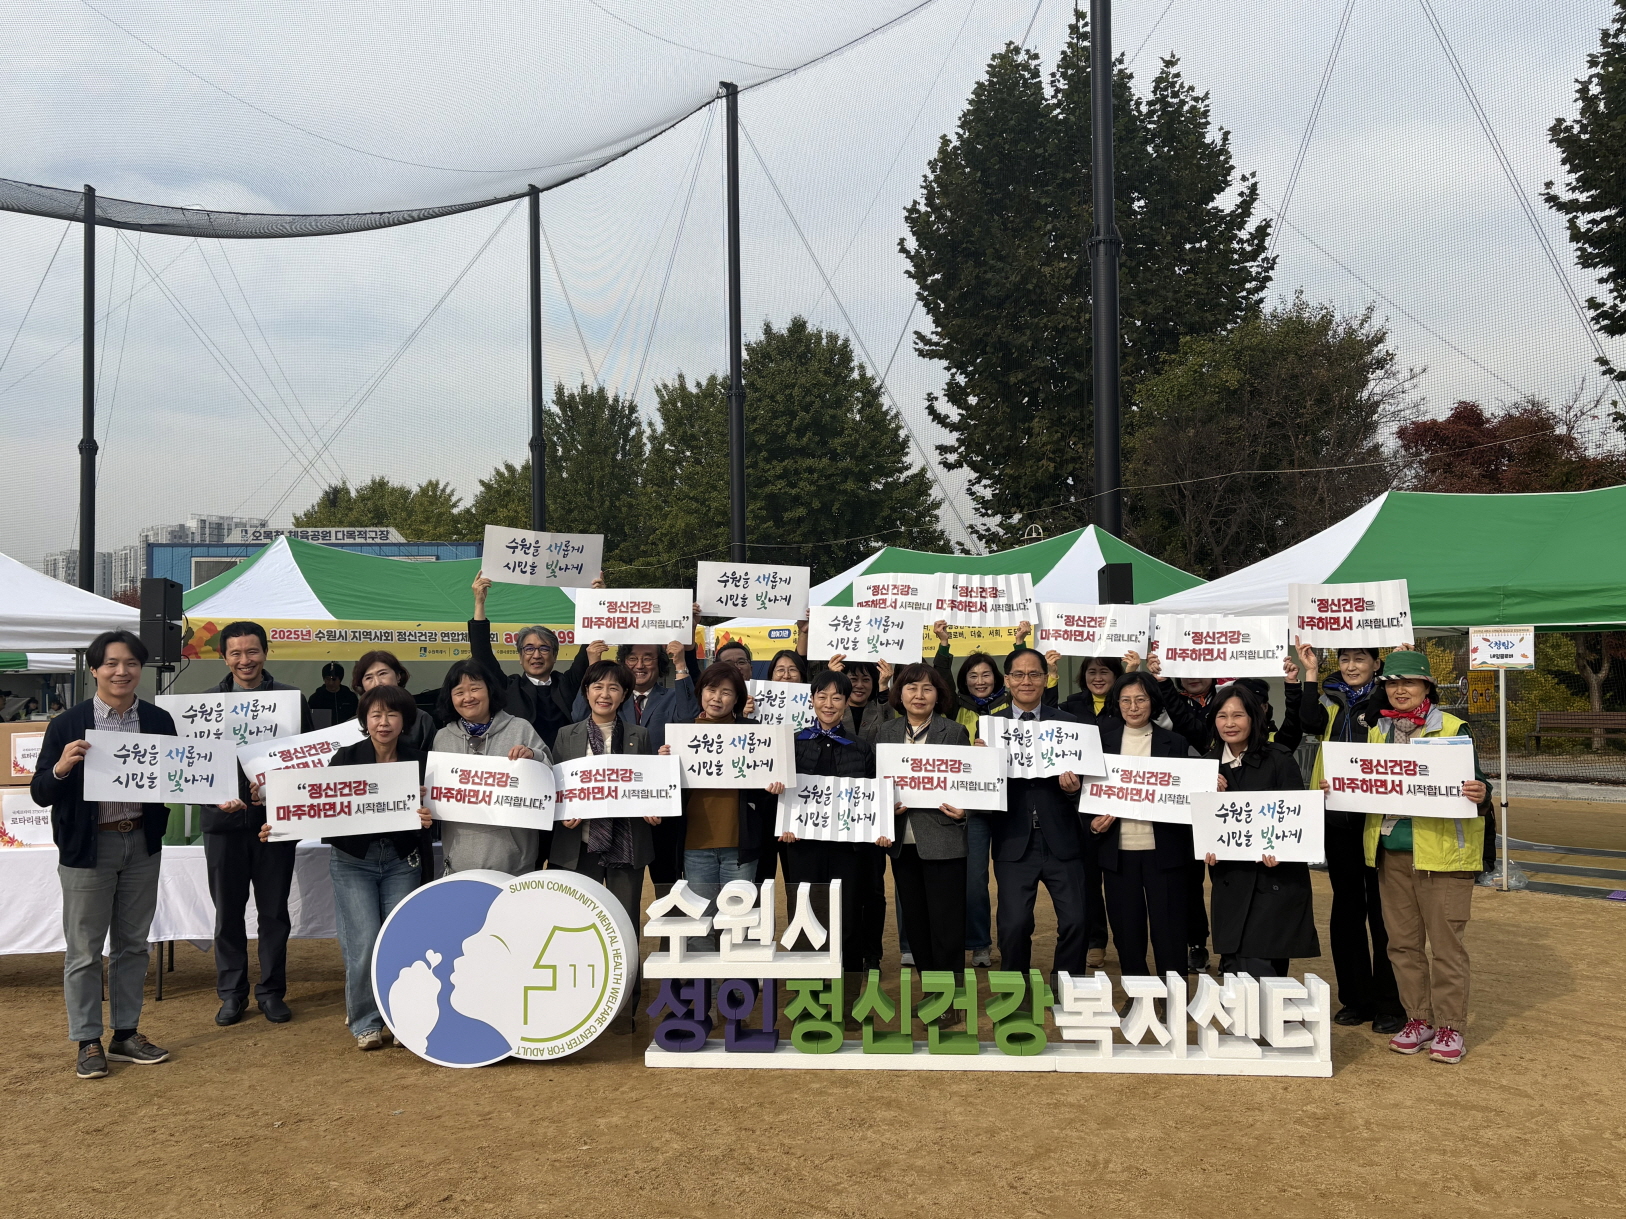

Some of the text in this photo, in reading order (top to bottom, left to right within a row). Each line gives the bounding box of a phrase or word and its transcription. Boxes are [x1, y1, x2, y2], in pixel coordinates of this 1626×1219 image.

[287, 530, 332, 541] 체육공원
[334, 530, 390, 541] 다목적구장
[505, 537, 584, 558] 수원을 새롭게
[503, 560, 584, 579] 시민을 빛나게
[717, 570, 791, 590] 수원을 새롭게
[716, 591, 792, 610] 시민을 빛나게
[952, 584, 1006, 599] “정신건강은
[599, 600, 661, 614] “정신건강은
[936, 599, 988, 613] 마주하면서
[1310, 597, 1375, 613] “정신건강은
[582, 615, 690, 630] 마주하면서 시작합니다.”
[829, 614, 904, 634] 수원을 새롭게
[1297, 611, 1407, 631] 마주하면서 시작합니다.”
[270, 629, 312, 641] 2025년
[314, 629, 348, 643] 수원시
[350, 629, 394, 643] 지역사회
[396, 631, 438, 643] 정신건강
[827, 637, 860, 651] 시민을
[867, 634, 904, 654] 빛나게
[1040, 629, 1095, 643] 마주하면서
[1184, 630, 1251, 646] “정신건강은
[1165, 644, 1284, 663] 마주하면서 시작합니다.”
[754, 689, 814, 710] 수원을 새롭
[182, 698, 276, 724] 수원을 새롭게
[792, 711, 815, 731] 빛나
[232, 722, 278, 746] 빛나게
[687, 732, 772, 754] 수원을 새롭게
[1001, 726, 1079, 747] 수원을 새롭게
[21, 752, 40, 760] 로타리
[113, 743, 213, 767] 수원을 새롭게
[268, 741, 342, 763] “정신건강은
[1041, 746, 1083, 769] 빛나게
[687, 756, 774, 779] 시민을 빛나게
[901, 756, 972, 773] “정신건강은
[1350, 757, 1430, 776] “정신건강은
[112, 769, 214, 793] 시민을 빛나게
[450, 767, 519, 788] “정신건강은
[570, 768, 644, 783] “정신건강은
[950, 777, 1004, 792] 시작합니다.”
[1111, 768, 1181, 787] “정신건강은
[297, 780, 379, 799] “정신건강은
[621, 784, 677, 800] 시작합니다.”
[798, 784, 875, 807] 수원을 새롭게
[1089, 783, 1156, 804] 마주하면서
[1332, 776, 1403, 796] 마주하면서
[276, 794, 416, 821] 마주하면서 시작합니다.”
[430, 786, 551, 811] 마주하면서 시작합니다.”
[11, 815, 49, 826] 로타리클럽
[795, 809, 877, 832] 시민을 빛나게
[1215, 799, 1301, 824] 수원을 새롭게
[1216, 825, 1302, 850] 시민을 빛나게
[642, 878, 842, 964] 수원시
[509, 880, 623, 1057] SUWON COMMUNITY MENTAL HEALTH WELFARE CENTER FOR ADULT
